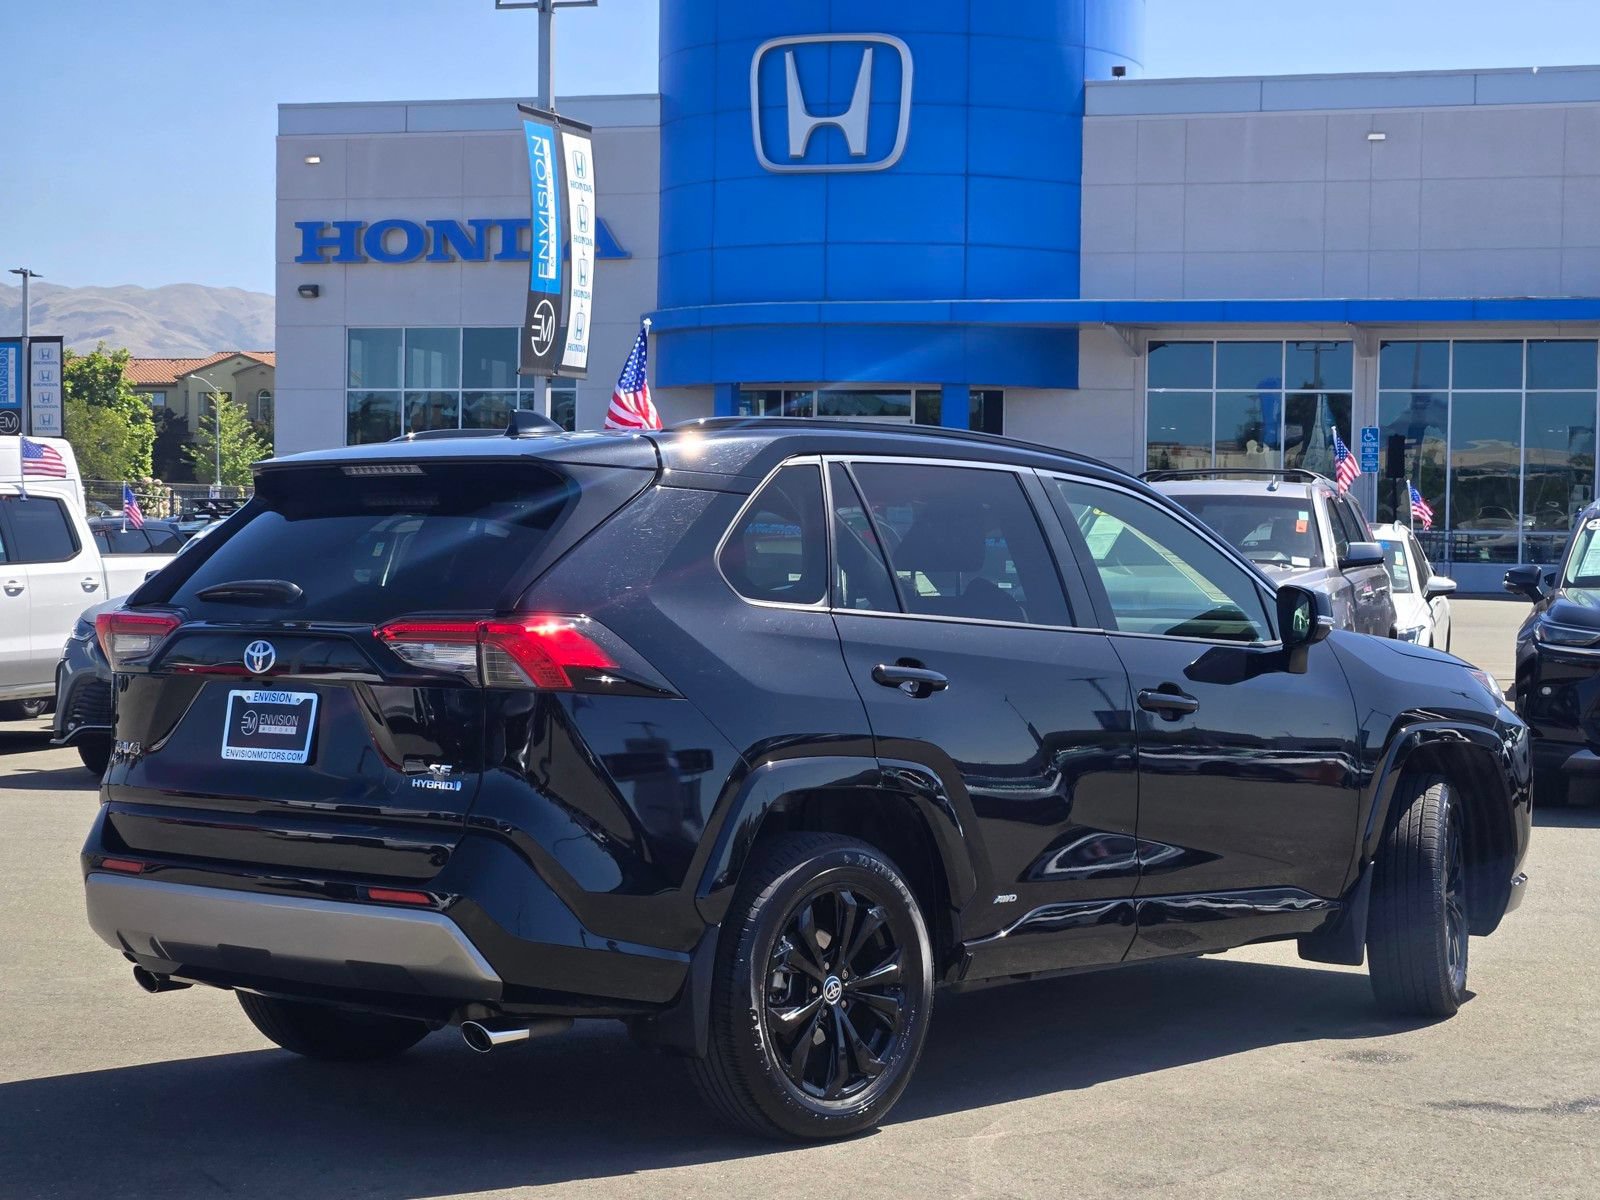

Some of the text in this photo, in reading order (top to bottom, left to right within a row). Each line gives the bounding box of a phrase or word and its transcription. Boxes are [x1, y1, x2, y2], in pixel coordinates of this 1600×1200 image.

[570, 179, 592, 193] HONDA
[531, 135, 550, 278] ENVISION
[573, 234, 592, 247] HONDA
[573, 288, 591, 300] HONDA
[567, 342, 585, 354] HONDA
[253, 692, 292, 703] ENVISION
[259, 713, 299, 726] ENVISION
[225, 748, 303, 761] ENVISIONMOTORS.COM
[412, 779, 455, 791] HYBRID
[993, 894, 1017, 904] AWD
